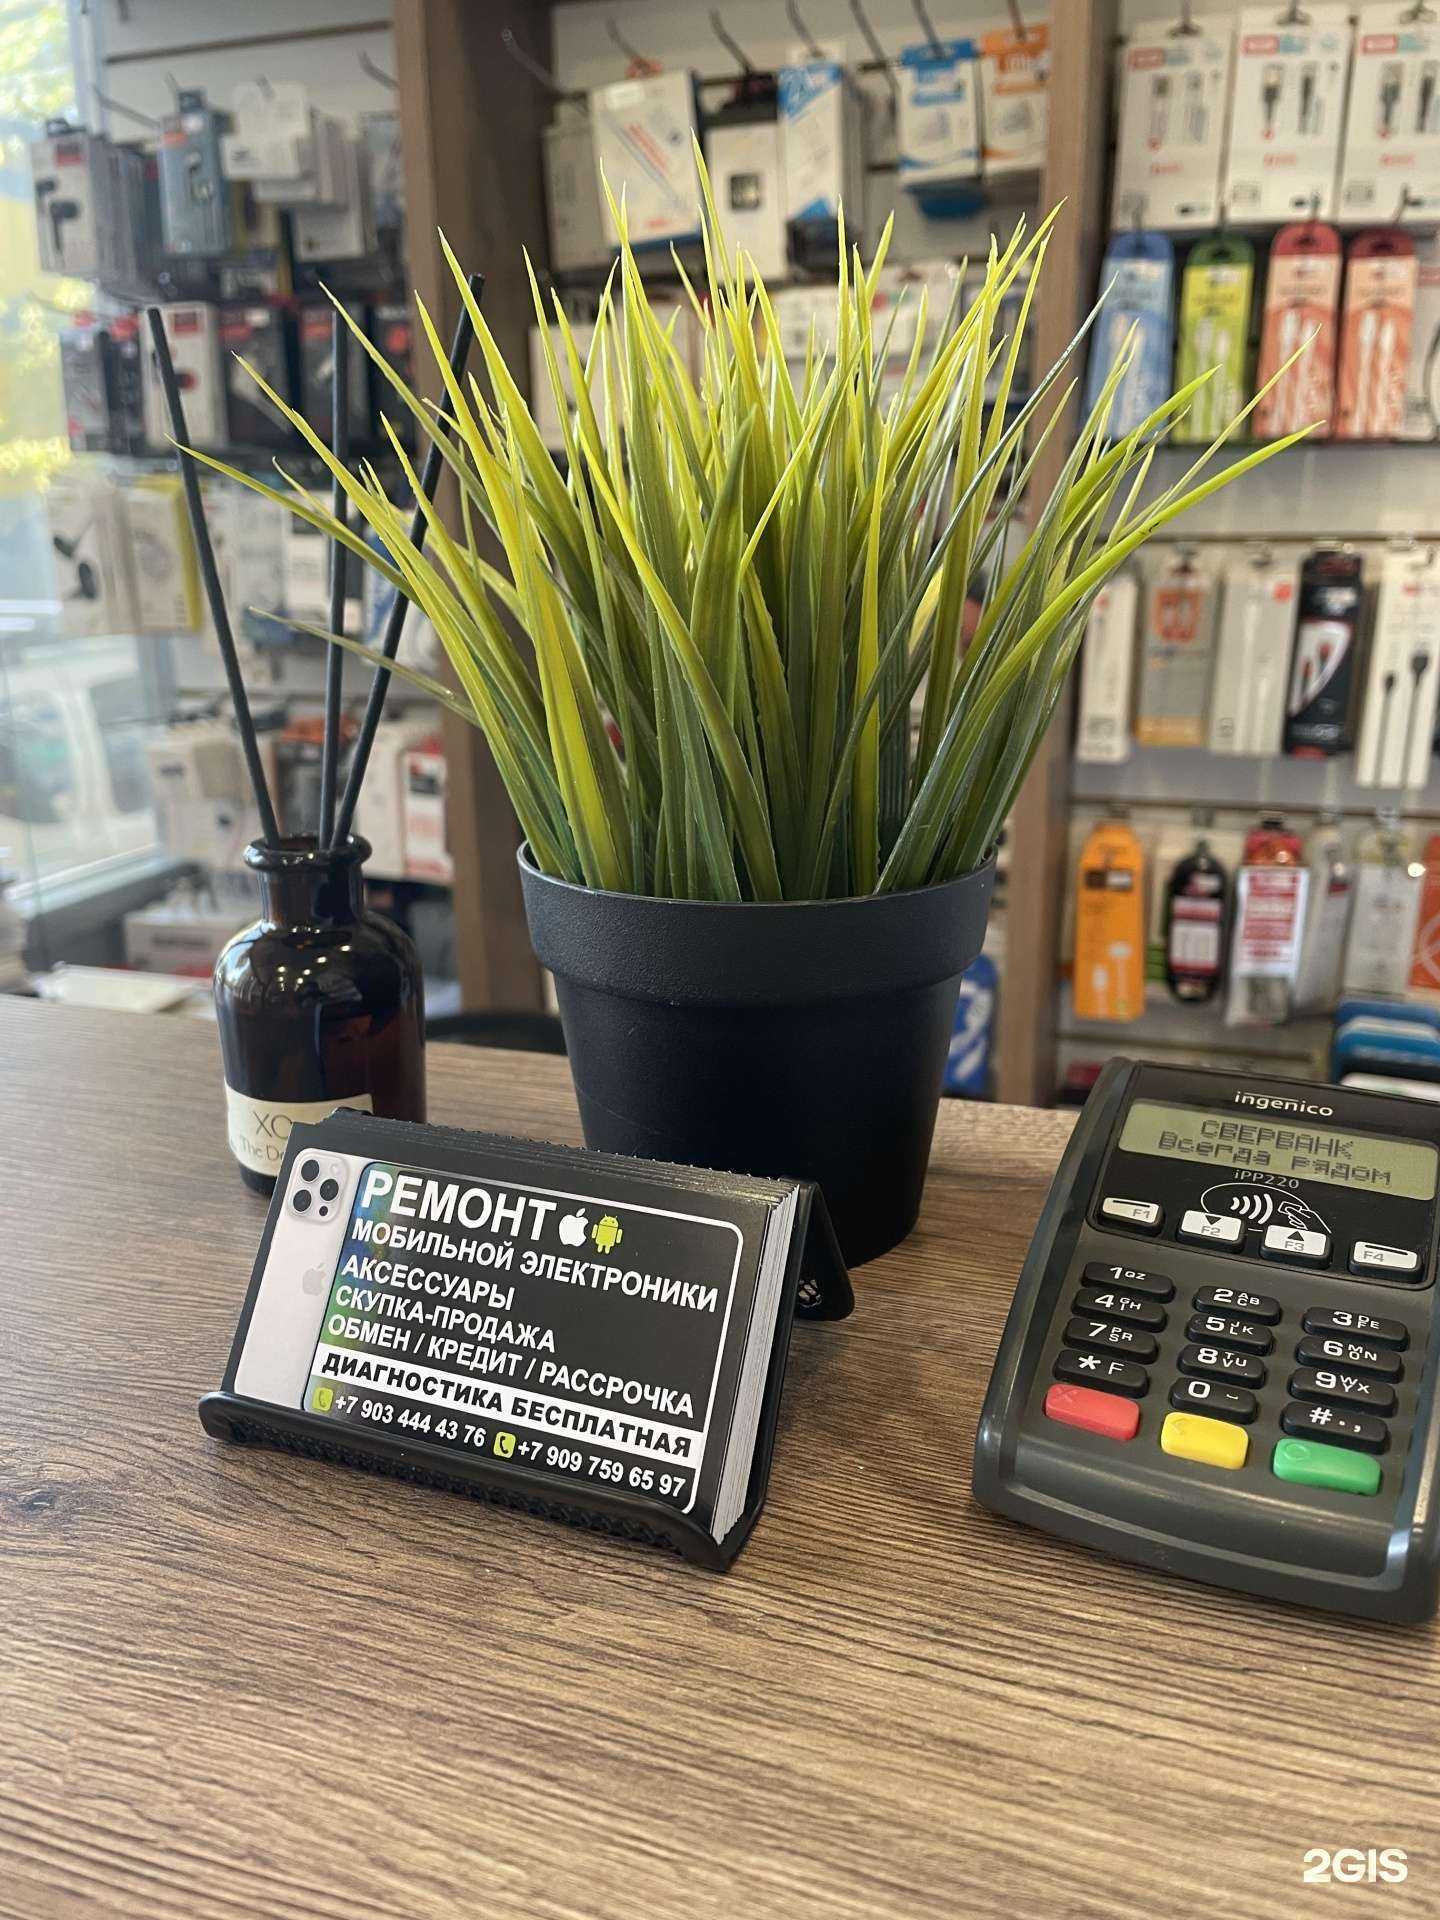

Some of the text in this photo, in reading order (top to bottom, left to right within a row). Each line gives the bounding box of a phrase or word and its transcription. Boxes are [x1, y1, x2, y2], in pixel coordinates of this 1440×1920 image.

[1235, 1091, 1334, 1117] ingenico
[361, 1170, 557, 1241] РЕМОНТ
[1234, 1169, 1300, 1189] iPP220
[1132, 1209, 1150, 1219] F1
[1201, 1225, 1221, 1237] F2
[352, 1218, 719, 1313] МОБИЛЬНОЙ ЭЛЕКТРОНИКИ
[1284, 1240, 1305, 1251] F3
[1363, 1251, 1385, 1262] F4
[341, 1255, 515, 1311] АКСЕССУАРЫ
[335, 1285, 556, 1353] СКУПКА-ПРОДАЖА
[328, 1314, 411, 1352] ОБМЕН
[427, 1335, 523, 1377] КРЕДИТ
[538, 1361, 694, 1419] РАССРОЧКА
[322, 1353, 692, 1458] ДИАГНОСТИКА БЕСПЛАТНАЯ
[335, 1395, 487, 1447] +7 903 444 43 76
[518, 1440, 686, 1497] +7 909 759 65 97
